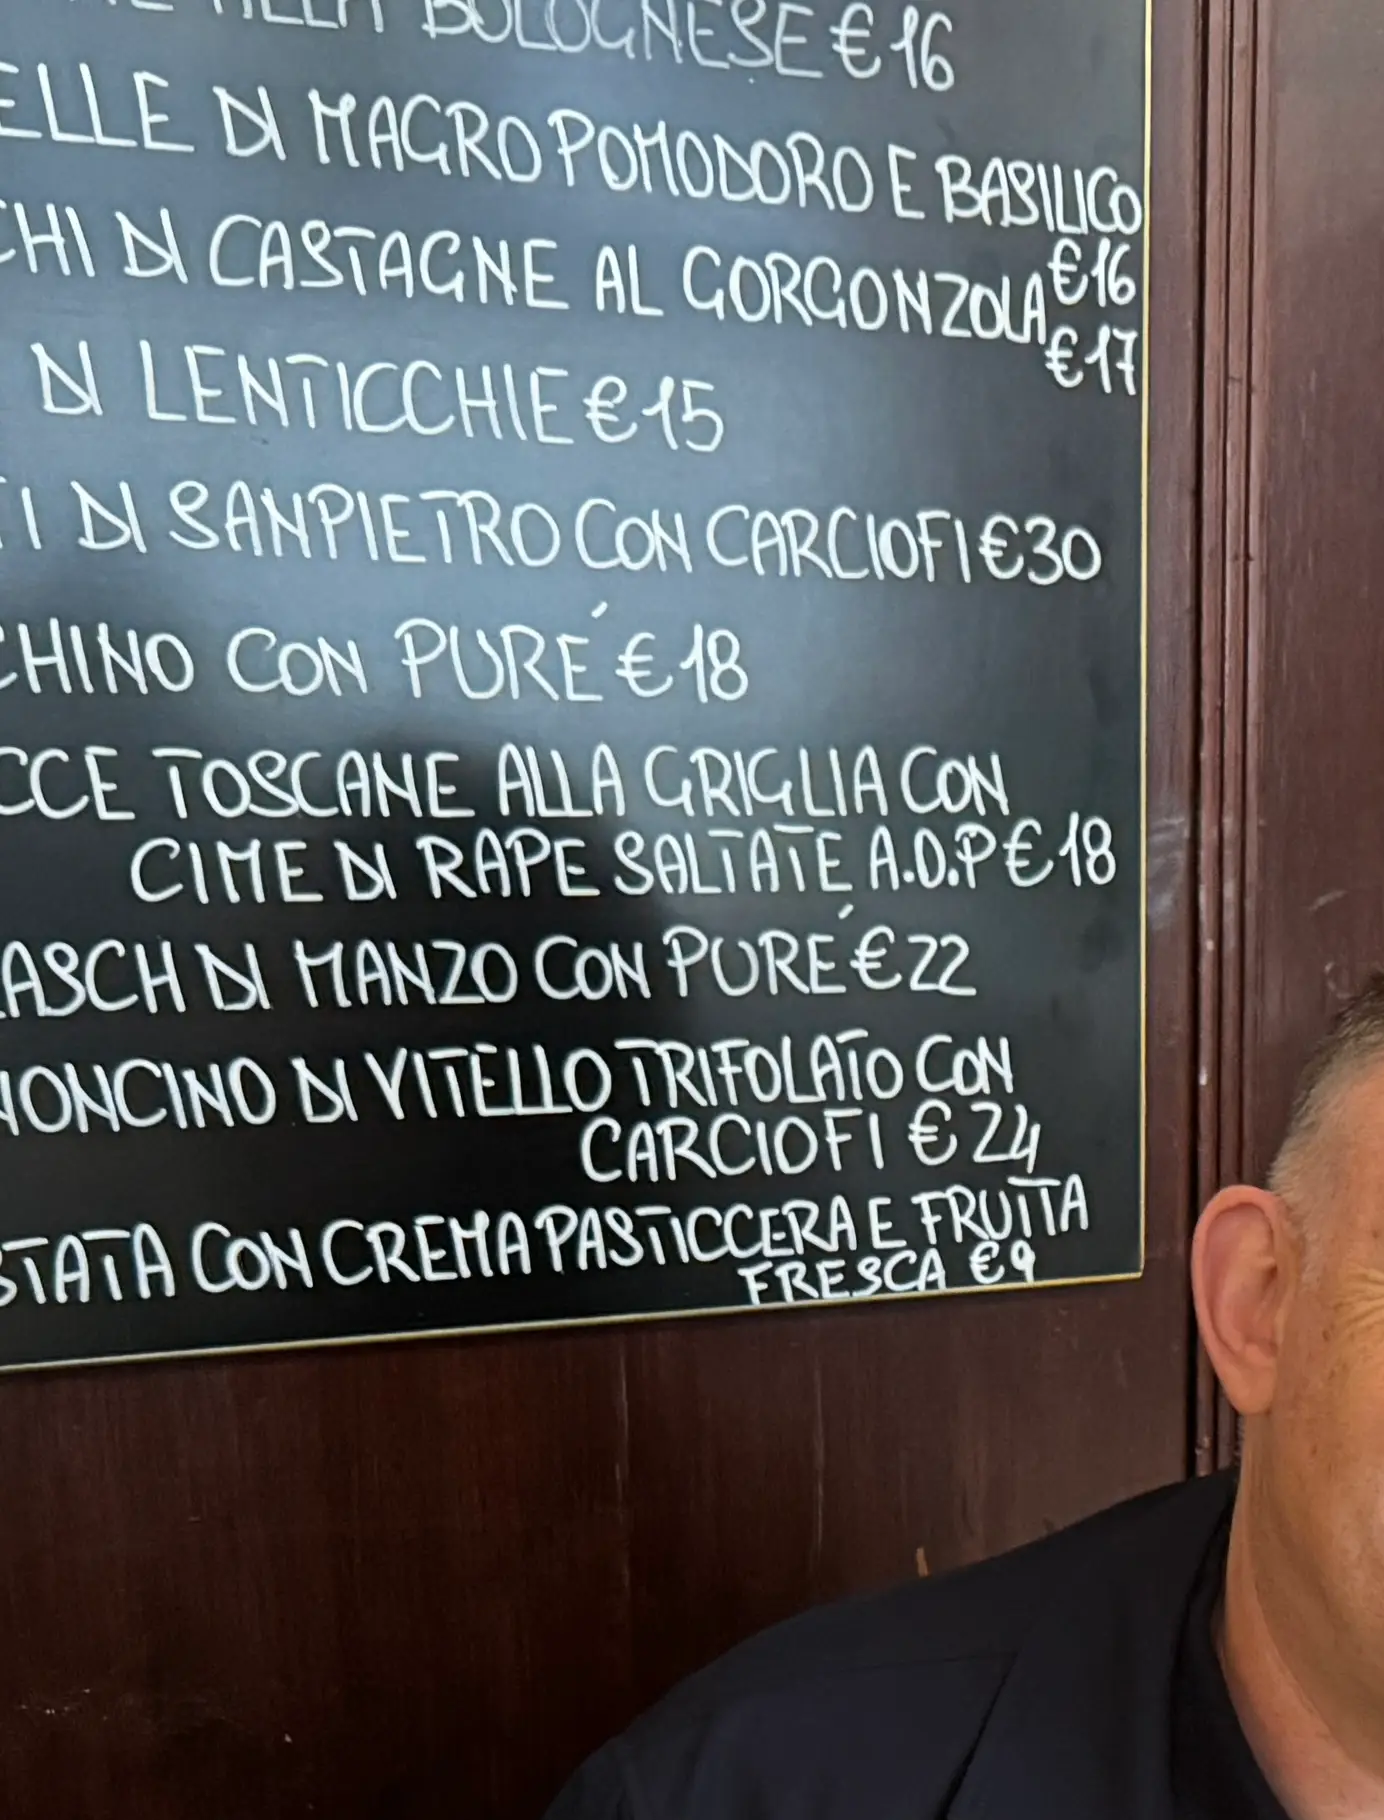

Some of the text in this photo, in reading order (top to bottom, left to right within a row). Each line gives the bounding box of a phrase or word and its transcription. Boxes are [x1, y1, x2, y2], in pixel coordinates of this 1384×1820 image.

[213, 86, 286, 160] DI
[308, 89, 541, 182] MAGRO
[548, 109, 873, 212] POMODORO
[888, 144, 925, 219] E
[935, 155, 1142, 234] BASILICO
[116, 208, 188, 283] DI
[210, 214, 569, 309] CASTAGNE
[596, 245, 663, 316] AL
[683, 246, 1046, 344] GORGONZOLA
[31, 341, 102, 415] DI
[140, 340, 573, 443] LENTICCHIE
[0, 475, 41, 549] I
[71, 481, 146, 553] DI
[575, 499, 692, 572] CON
[707, 505, 970, 583] CARCIOFI
[227, 628, 367, 696] CON
[152, 748, 475, 818] TOSCANE
[499, 743, 625, 817] ALLA
[645, 745, 887, 816] GRIGLIA
[901, 746, 1009, 816] CON
[131, 838, 323, 904] CIME
[334, 841, 396, 900] DI
[416, 828, 600, 898] RAPE
[615, 824, 852, 894] SALTATE
[0, 939, 186, 1017] ASCH
[195, 943, 271, 1010] DI
[294, 940, 517, 1007] MANZO
[535, 935, 651, 1000] CON
[291, 1057, 358, 1123] DI
[365, 1044, 611, 1120] VITELLO
[614, 1029, 903, 1108] TRIFOLATO
[916, 1035, 1013, 1095] CON
[581, 1108, 884, 1182] CARCIOFI
[192, 1222, 313, 1293] CON
[322, 1210, 531, 1285] CREMA
[535, 1195, 856, 1272] PASTICCERA
[869, 1197, 907, 1248] E
[911, 1174, 1088, 1244] FRUTTA
[737, 1247, 947, 1305] FRESCA
